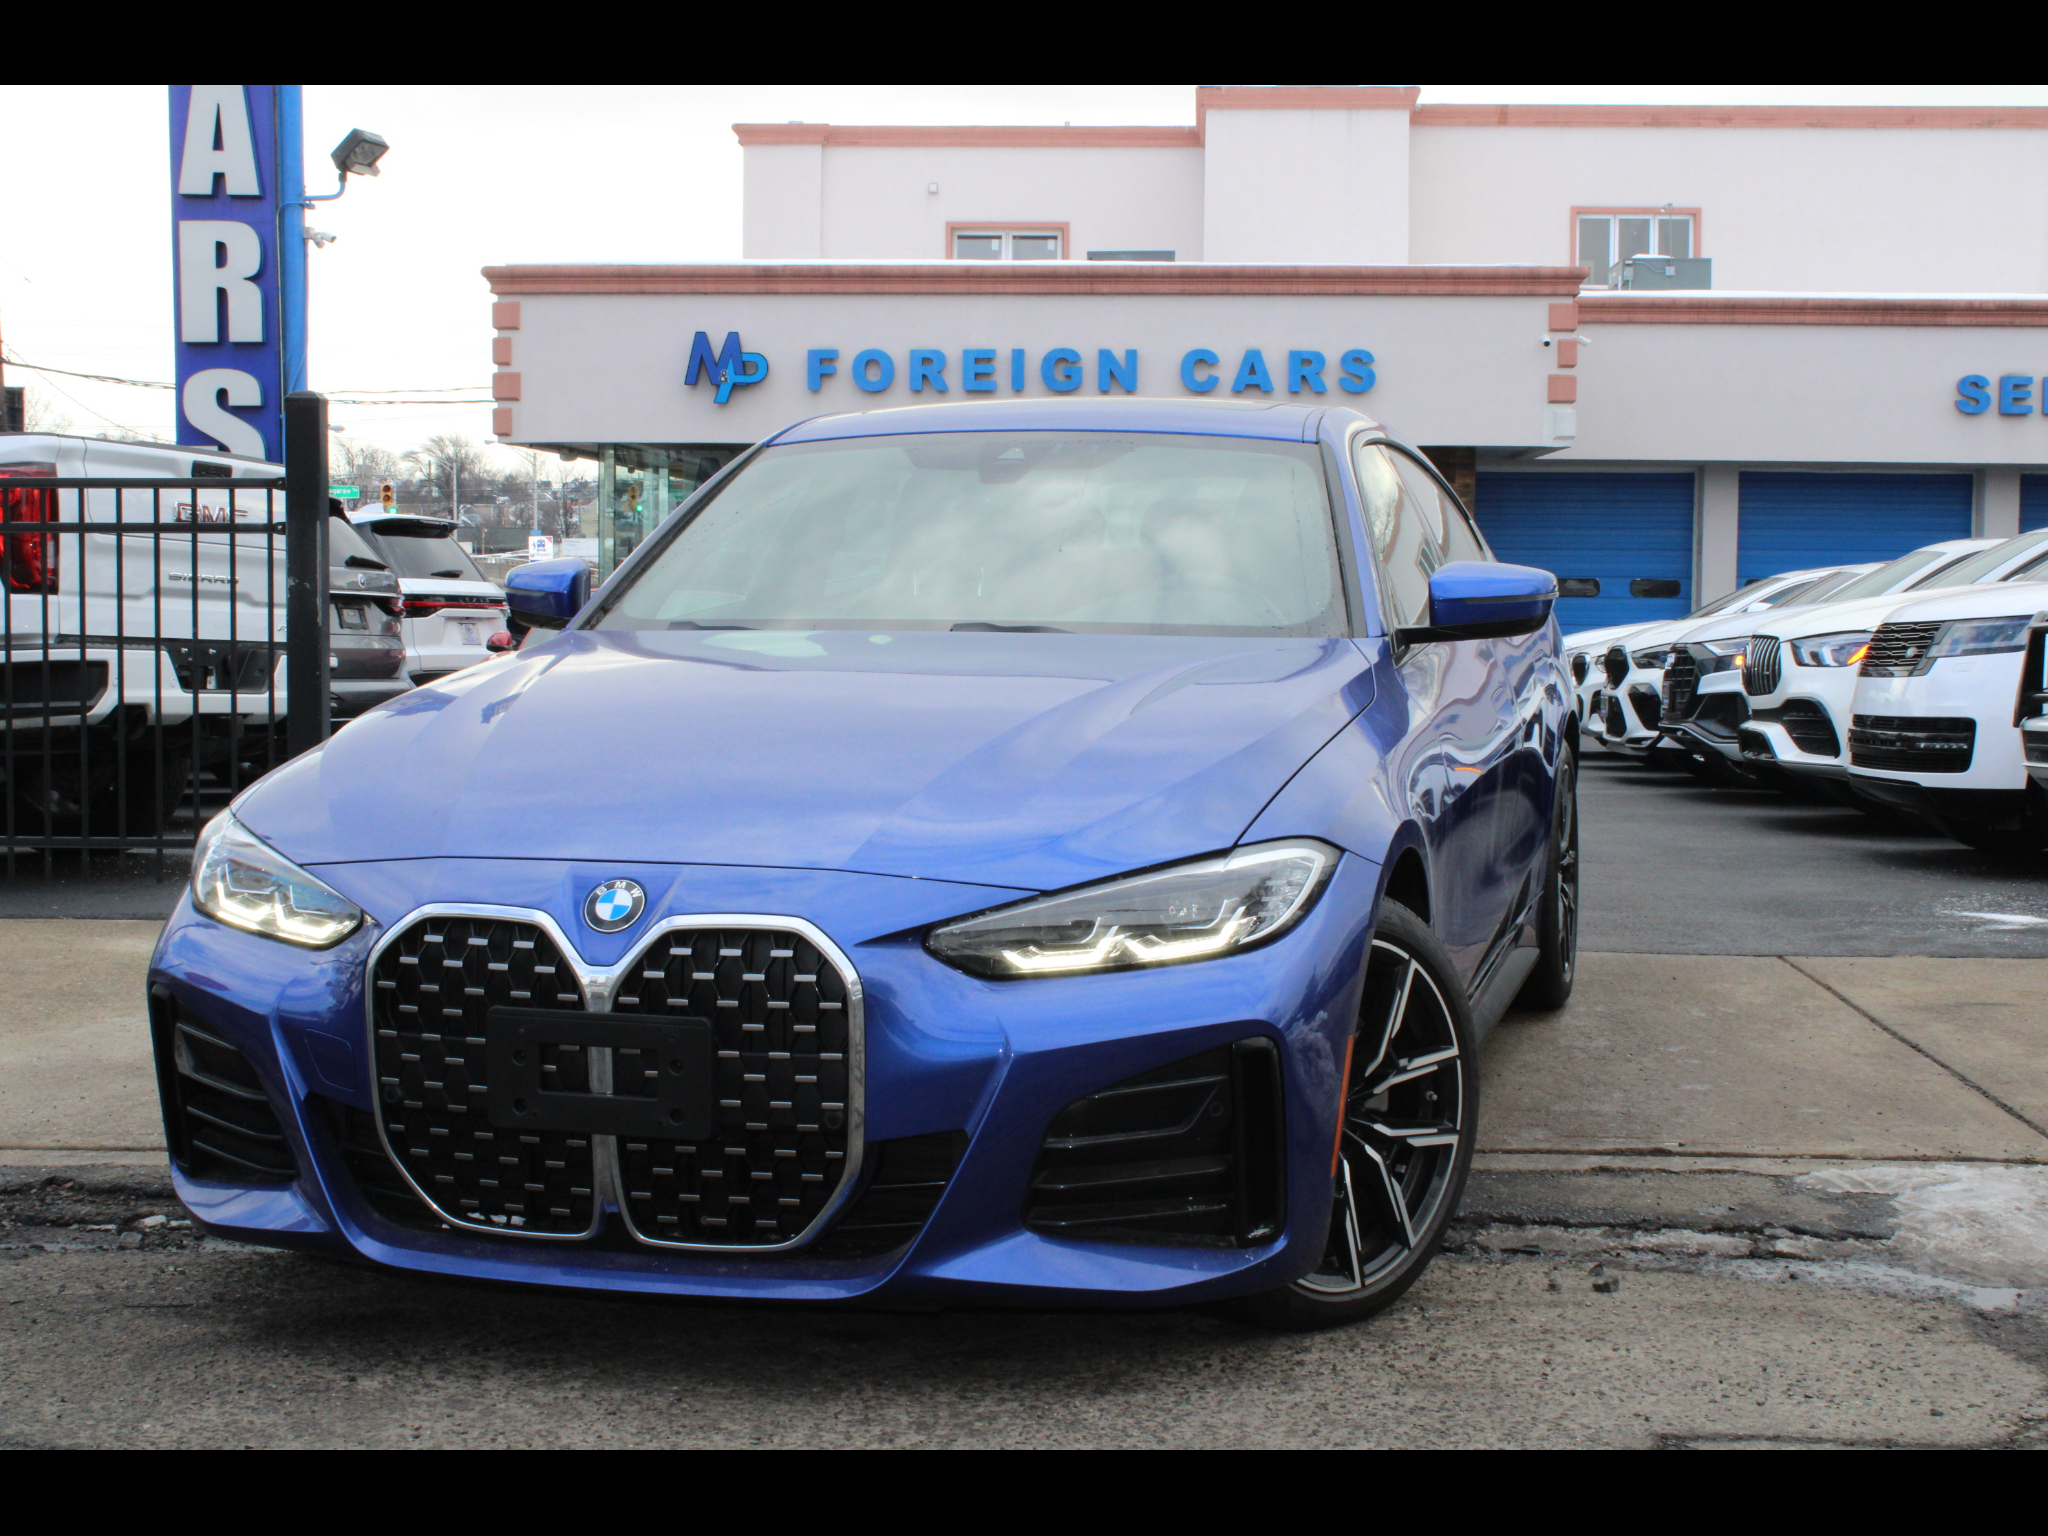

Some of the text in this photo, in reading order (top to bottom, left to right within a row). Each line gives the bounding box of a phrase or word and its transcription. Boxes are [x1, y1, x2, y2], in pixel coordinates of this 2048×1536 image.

[807, 347, 1138, 394] FOREIGN
[1180, 347, 1378, 394] CARS
[1955, 374, 2048, 416] SE
[596, 881, 642, 898] BMW
